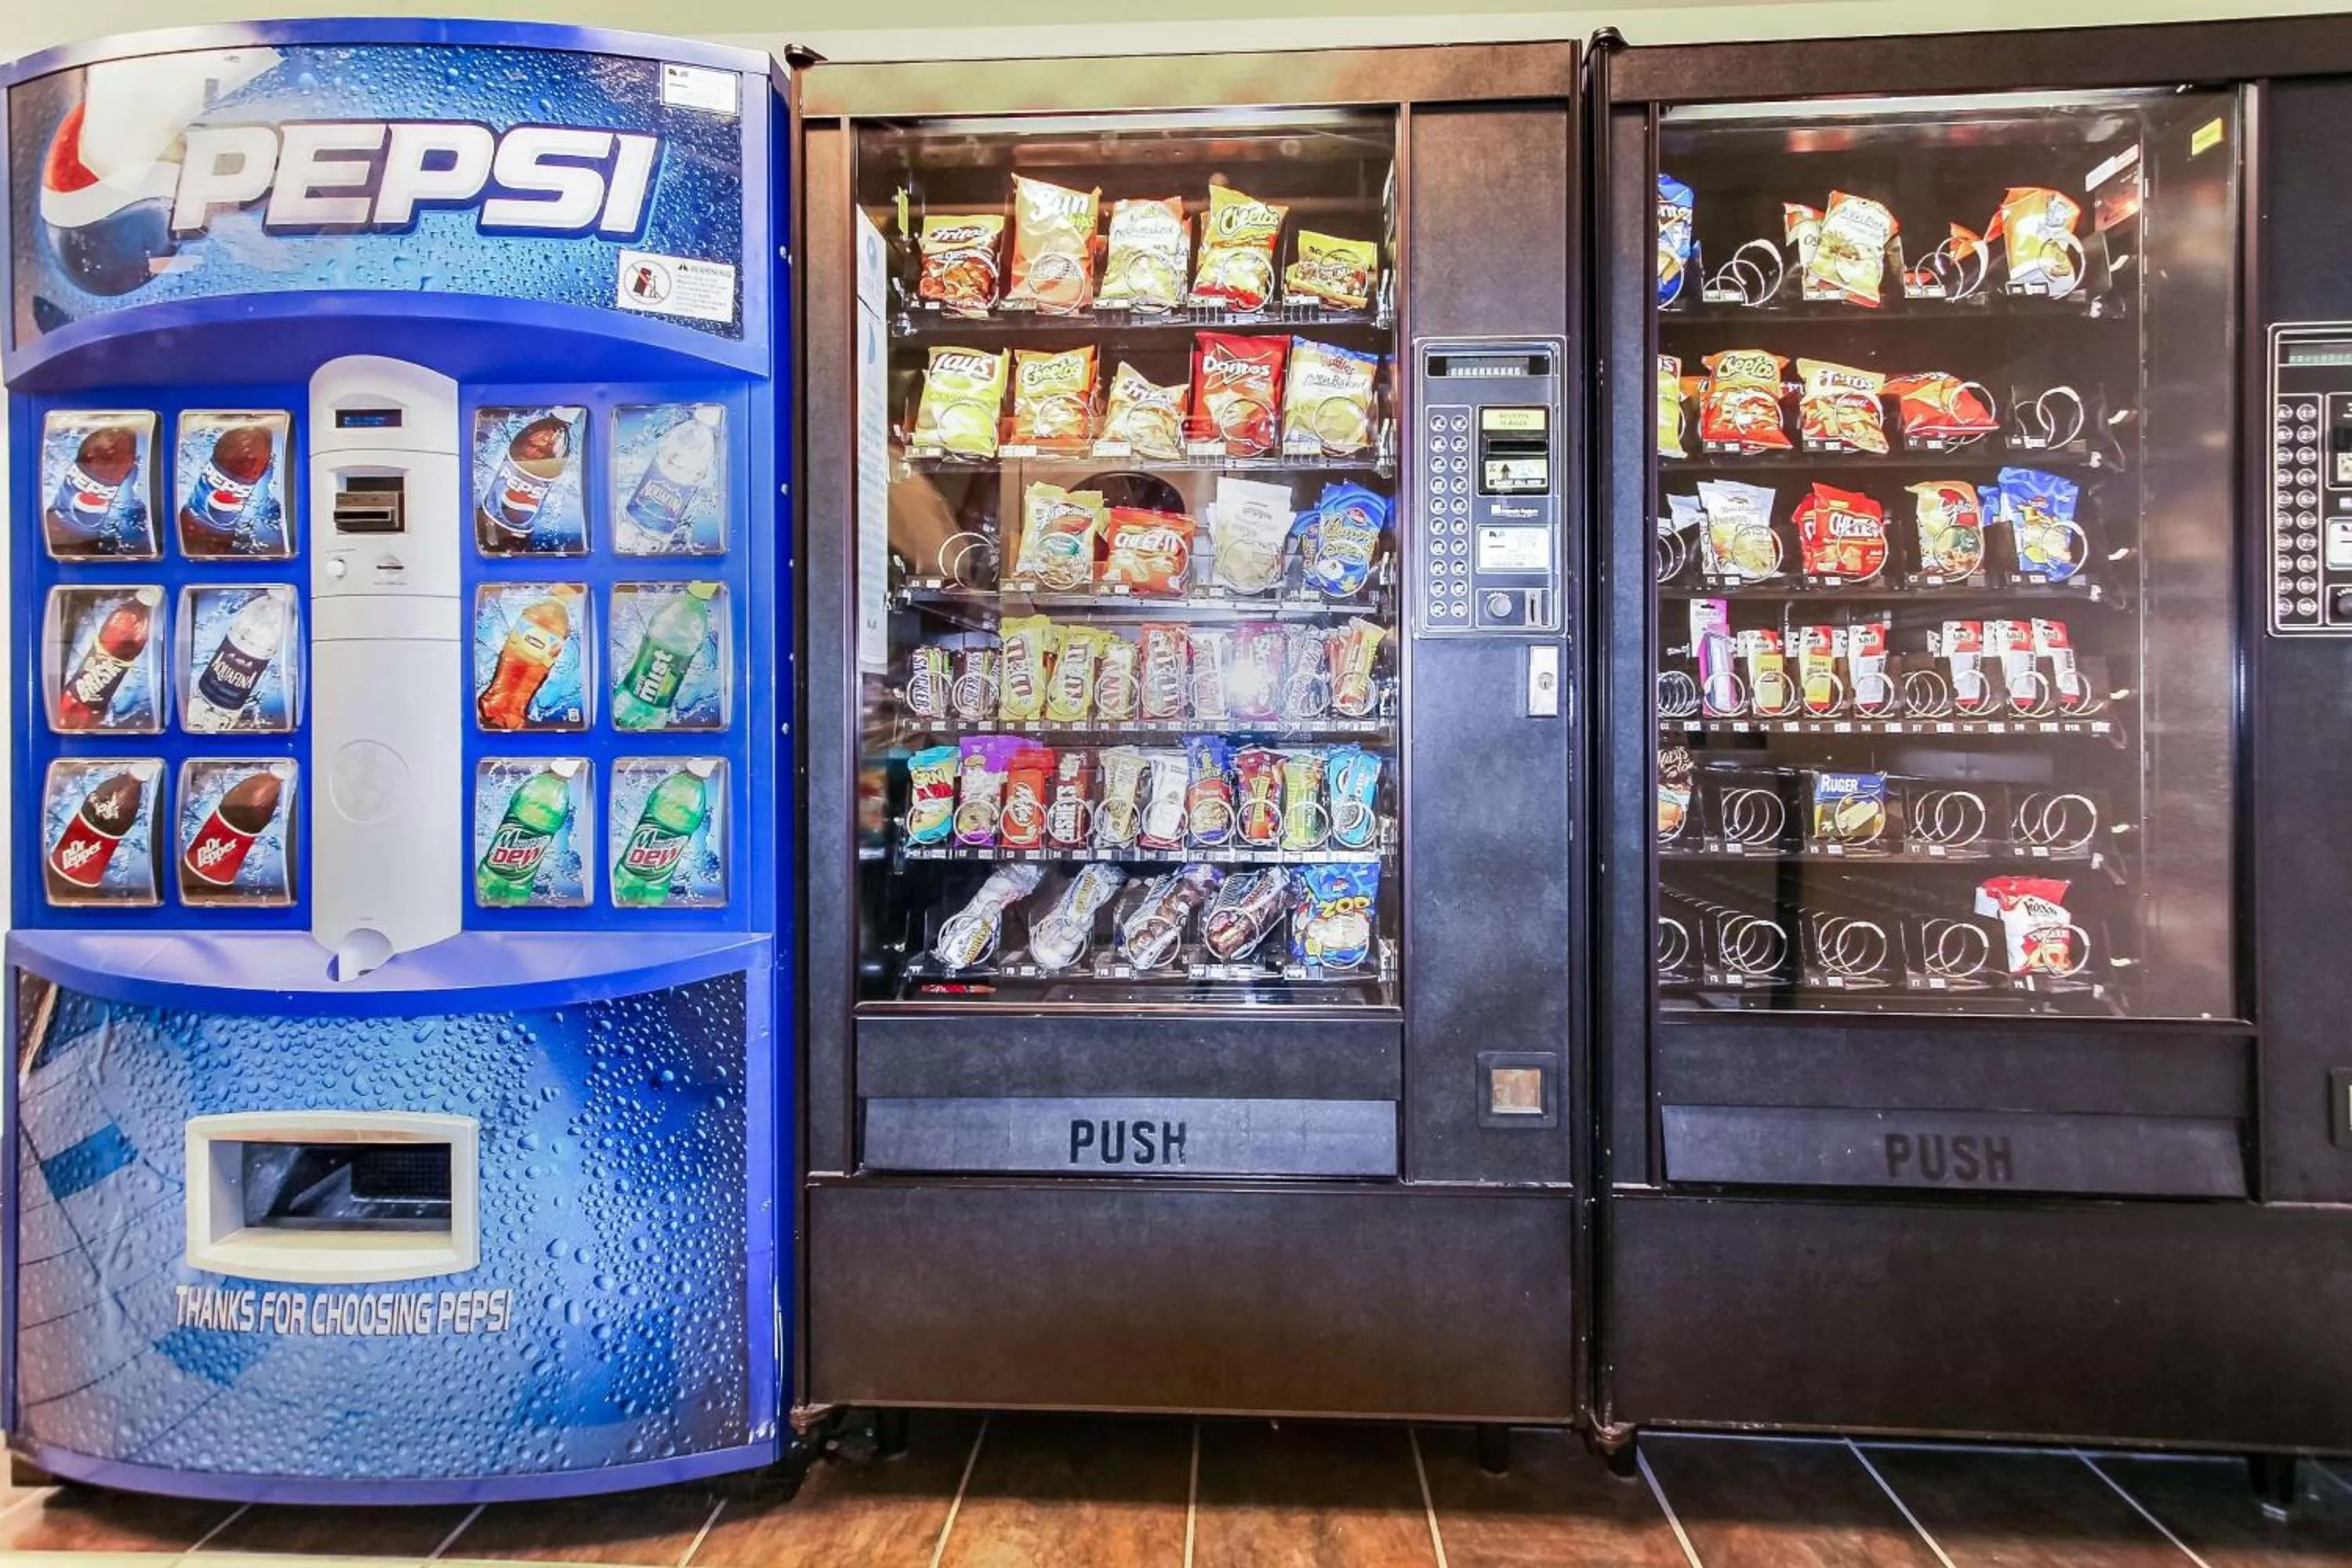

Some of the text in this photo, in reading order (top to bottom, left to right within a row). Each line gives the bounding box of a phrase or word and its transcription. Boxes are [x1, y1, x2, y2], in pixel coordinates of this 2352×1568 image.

[171, 121, 666, 239] PEPSI
[1202, 356, 1271, 379] Doritos
[65, 464, 119, 500] PEPS
[201, 464, 253, 499] PEPS
[211, 658, 258, 690] AQUAFINA
[638, 646, 670, 695] mist
[1820, 775, 1859, 793] RUGER
[62, 840, 102, 870] Pepper
[71, 839, 86, 852] Dr
[197, 839, 238, 868] Pepper
[205, 837, 220, 850] Dr
[1070, 1119, 1187, 1167] PUSH
[1885, 1133, 2013, 1181] PUSH
[175, 1285, 514, 1335] THANKS FOR CHOOSING PEPSI
